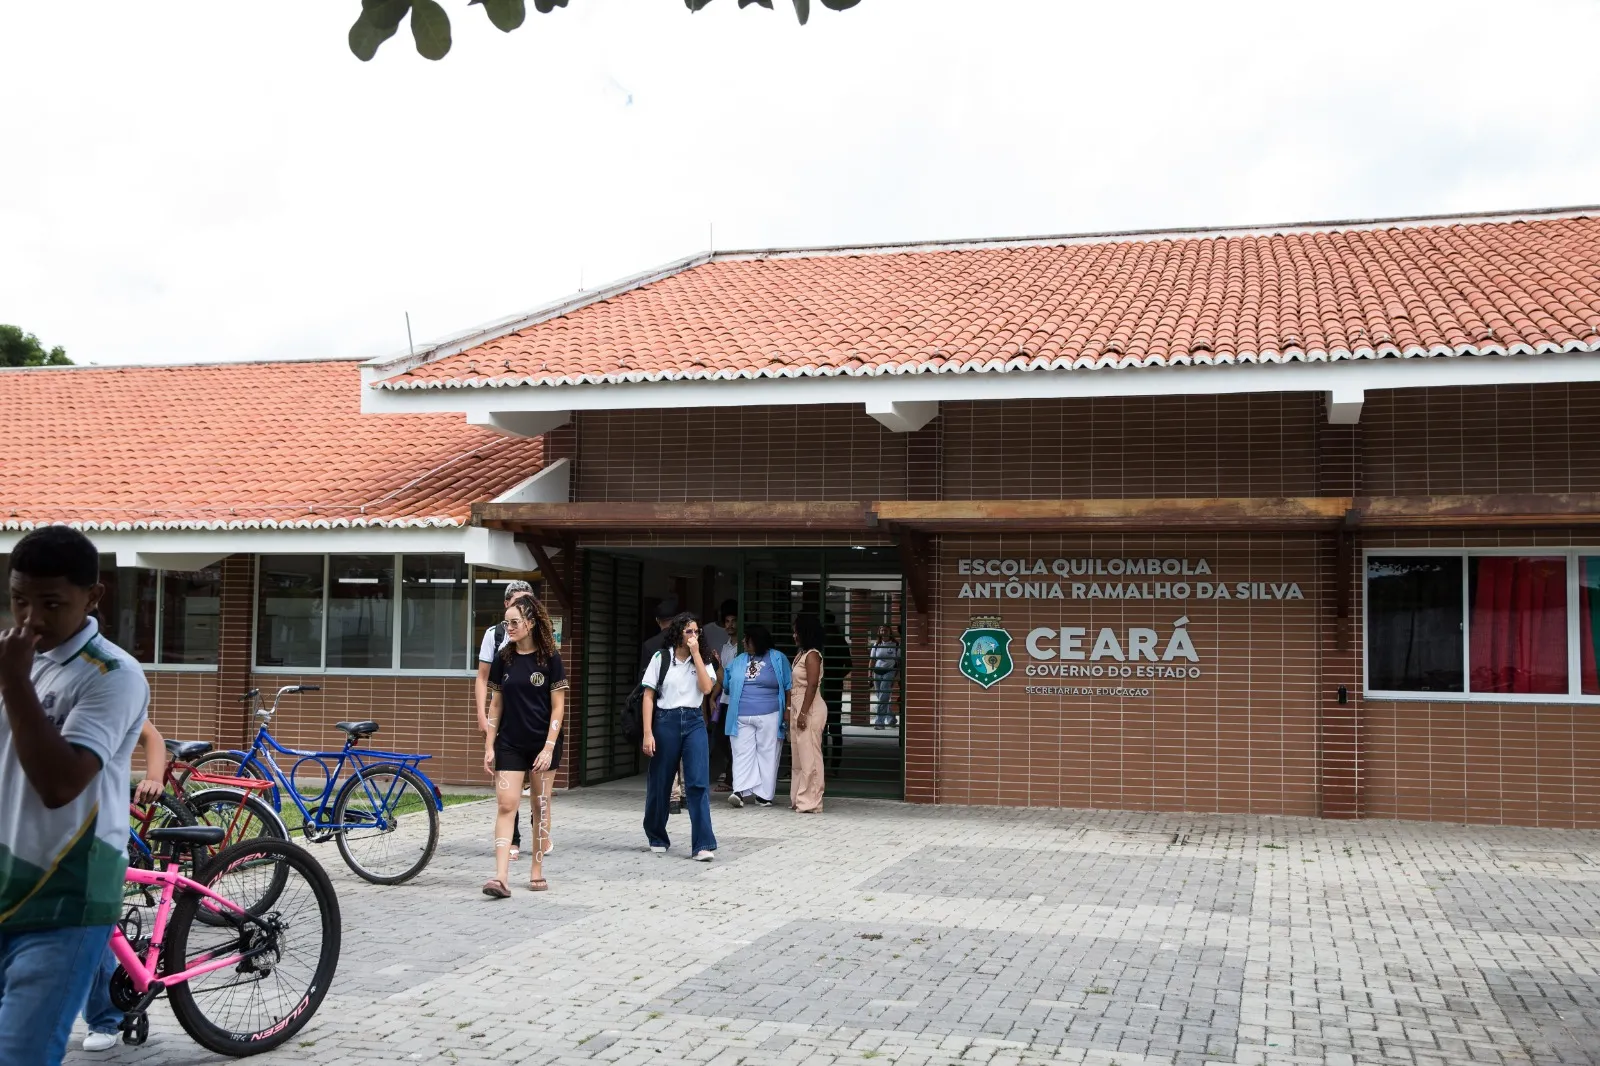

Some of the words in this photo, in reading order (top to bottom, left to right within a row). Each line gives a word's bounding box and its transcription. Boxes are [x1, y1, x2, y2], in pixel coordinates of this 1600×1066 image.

[958, 558, 1049, 576] ESCOLA
[1051, 558, 1213, 578] QUILOMBOLA
[958, 576, 1065, 599] ANTÔNIA
[1071, 582, 1191, 600] RAMALHO
[1196, 582, 1232, 600] DA
[1235, 582, 1305, 600] SILVA
[1025, 615, 1200, 662] CEARÁ
[1025, 664, 1104, 677] GOVERNO
[1108, 665, 1132, 678] DO
[1136, 665, 1201, 679] ESTADO
[1025, 686, 1079, 695] SECRETARIA
[1081, 687, 1094, 695] DA
[250, 994, 310, 1042] QUEEN
